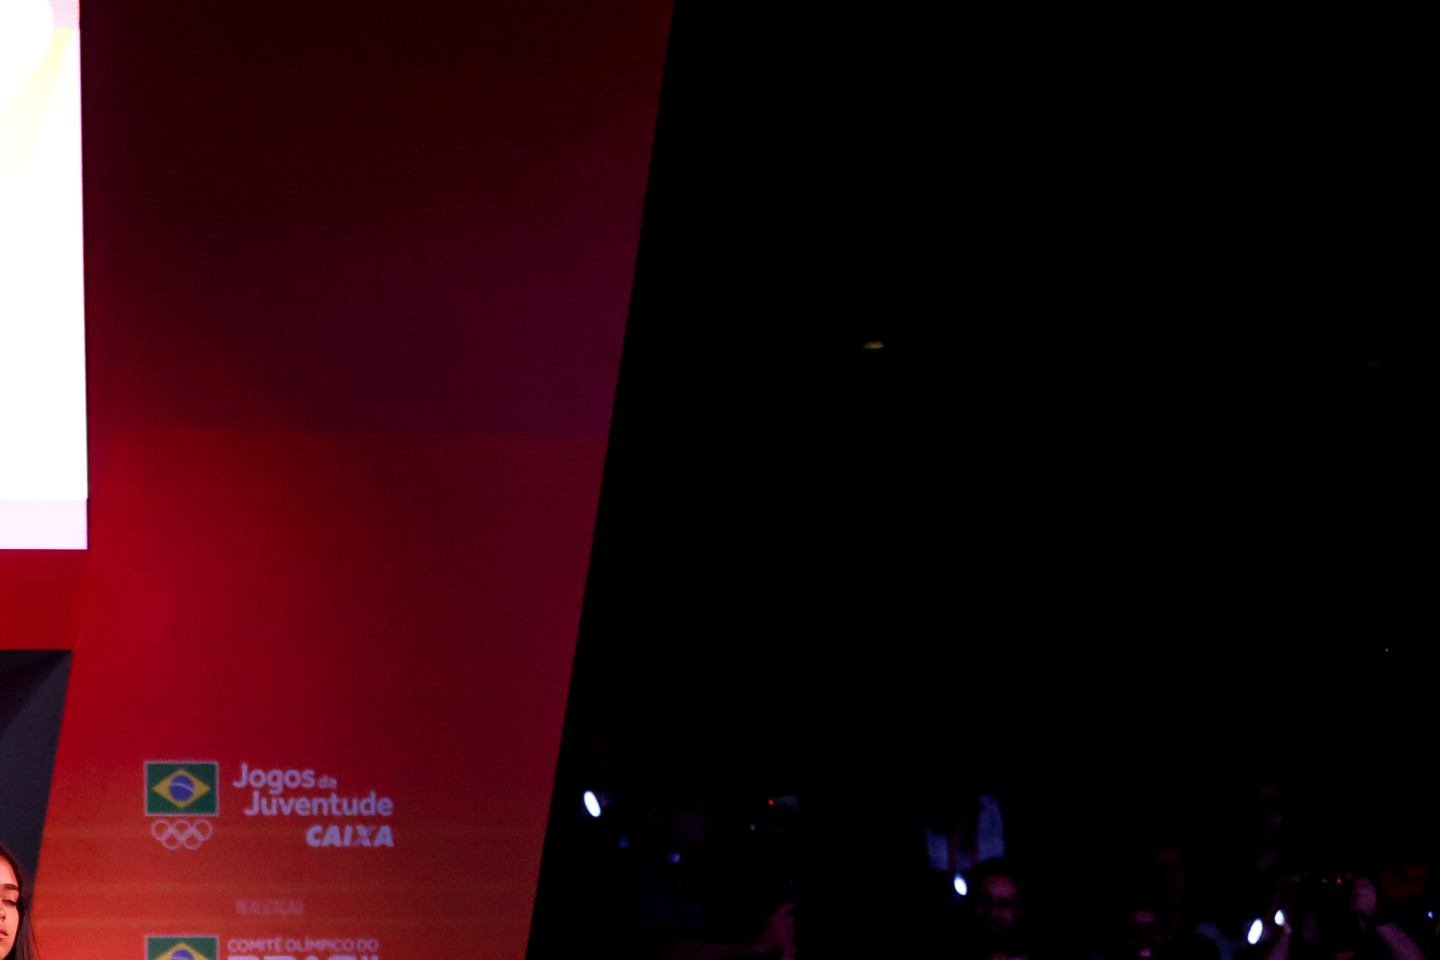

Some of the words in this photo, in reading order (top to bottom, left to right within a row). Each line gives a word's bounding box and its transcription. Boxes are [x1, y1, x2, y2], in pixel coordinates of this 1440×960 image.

[232, 763, 315, 794] Jogos
[318, 775, 337, 789] da
[244, 790, 394, 816] Juventude
[306, 825, 394, 847] CAIXA
